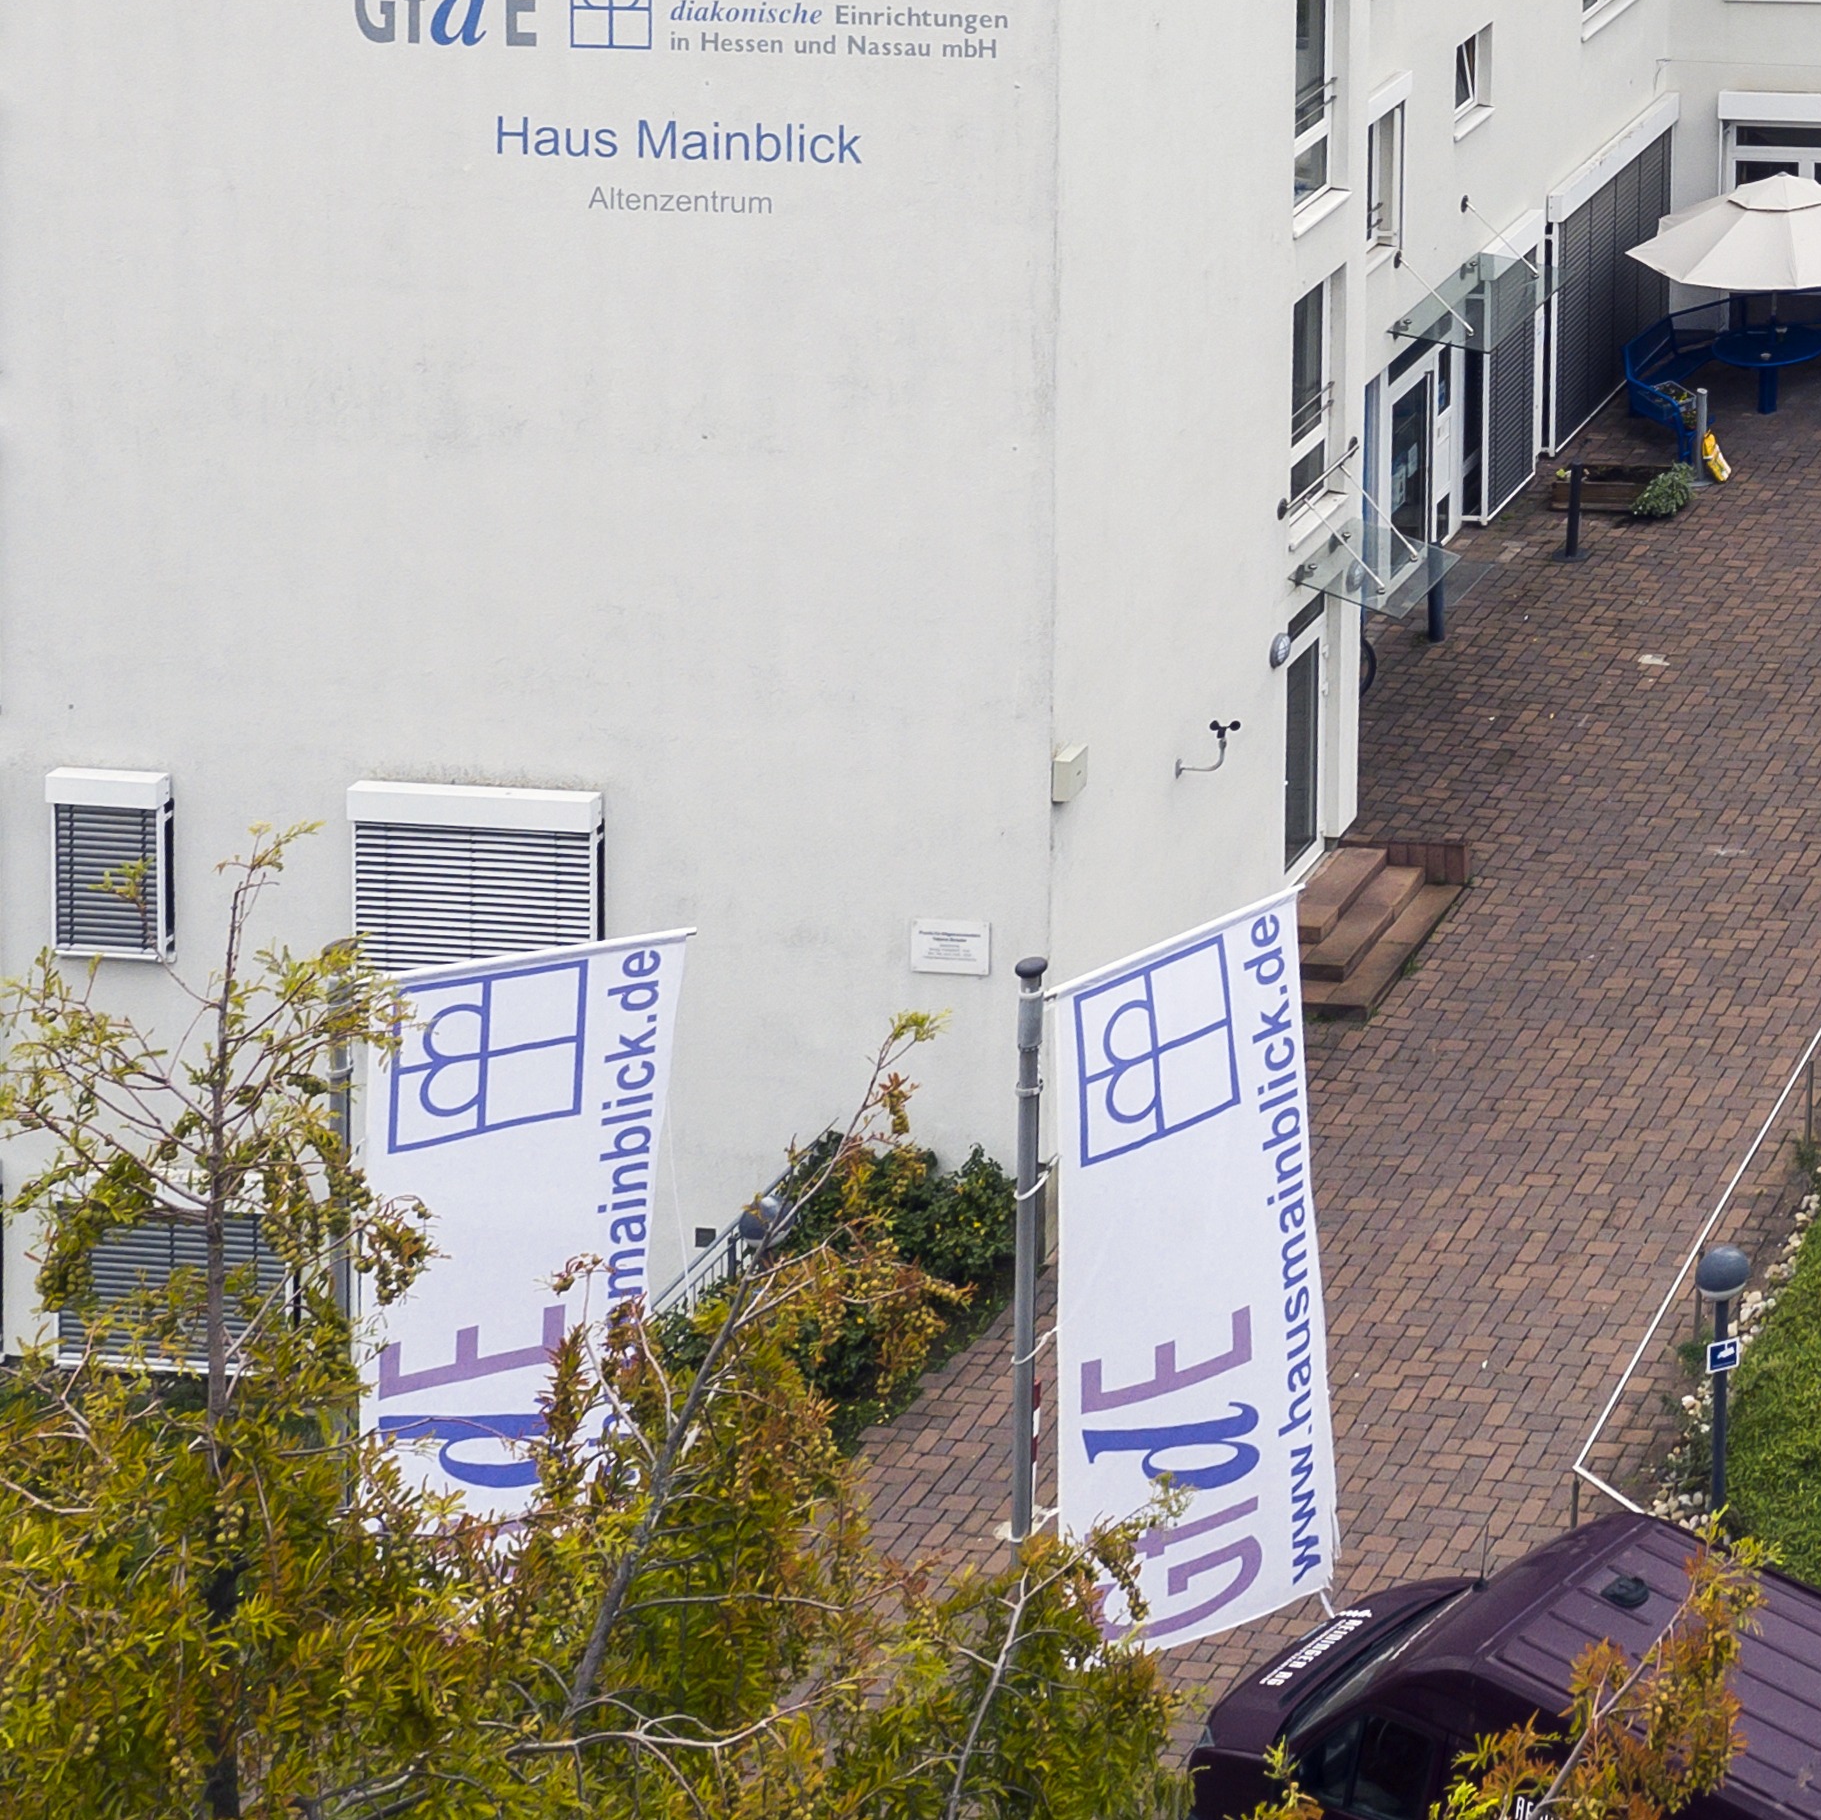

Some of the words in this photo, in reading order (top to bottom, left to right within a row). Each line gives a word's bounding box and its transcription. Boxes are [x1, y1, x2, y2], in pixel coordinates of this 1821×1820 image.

[834, 4, 1009, 31] Einrichtungen
[669, 31, 690, 52] in
[700, 31, 784, 55] Hessen
[794, 34, 836, 56] und
[847, 36, 931, 59] Nassau
[942, 38, 997, 60] mbH
[495, 115, 619, 159] Haus
[637, 118, 863, 165] Mainblick
[587, 185, 774, 216] Altenzentrum
[1242, 913, 1322, 1585] www.hausmainblick.de
